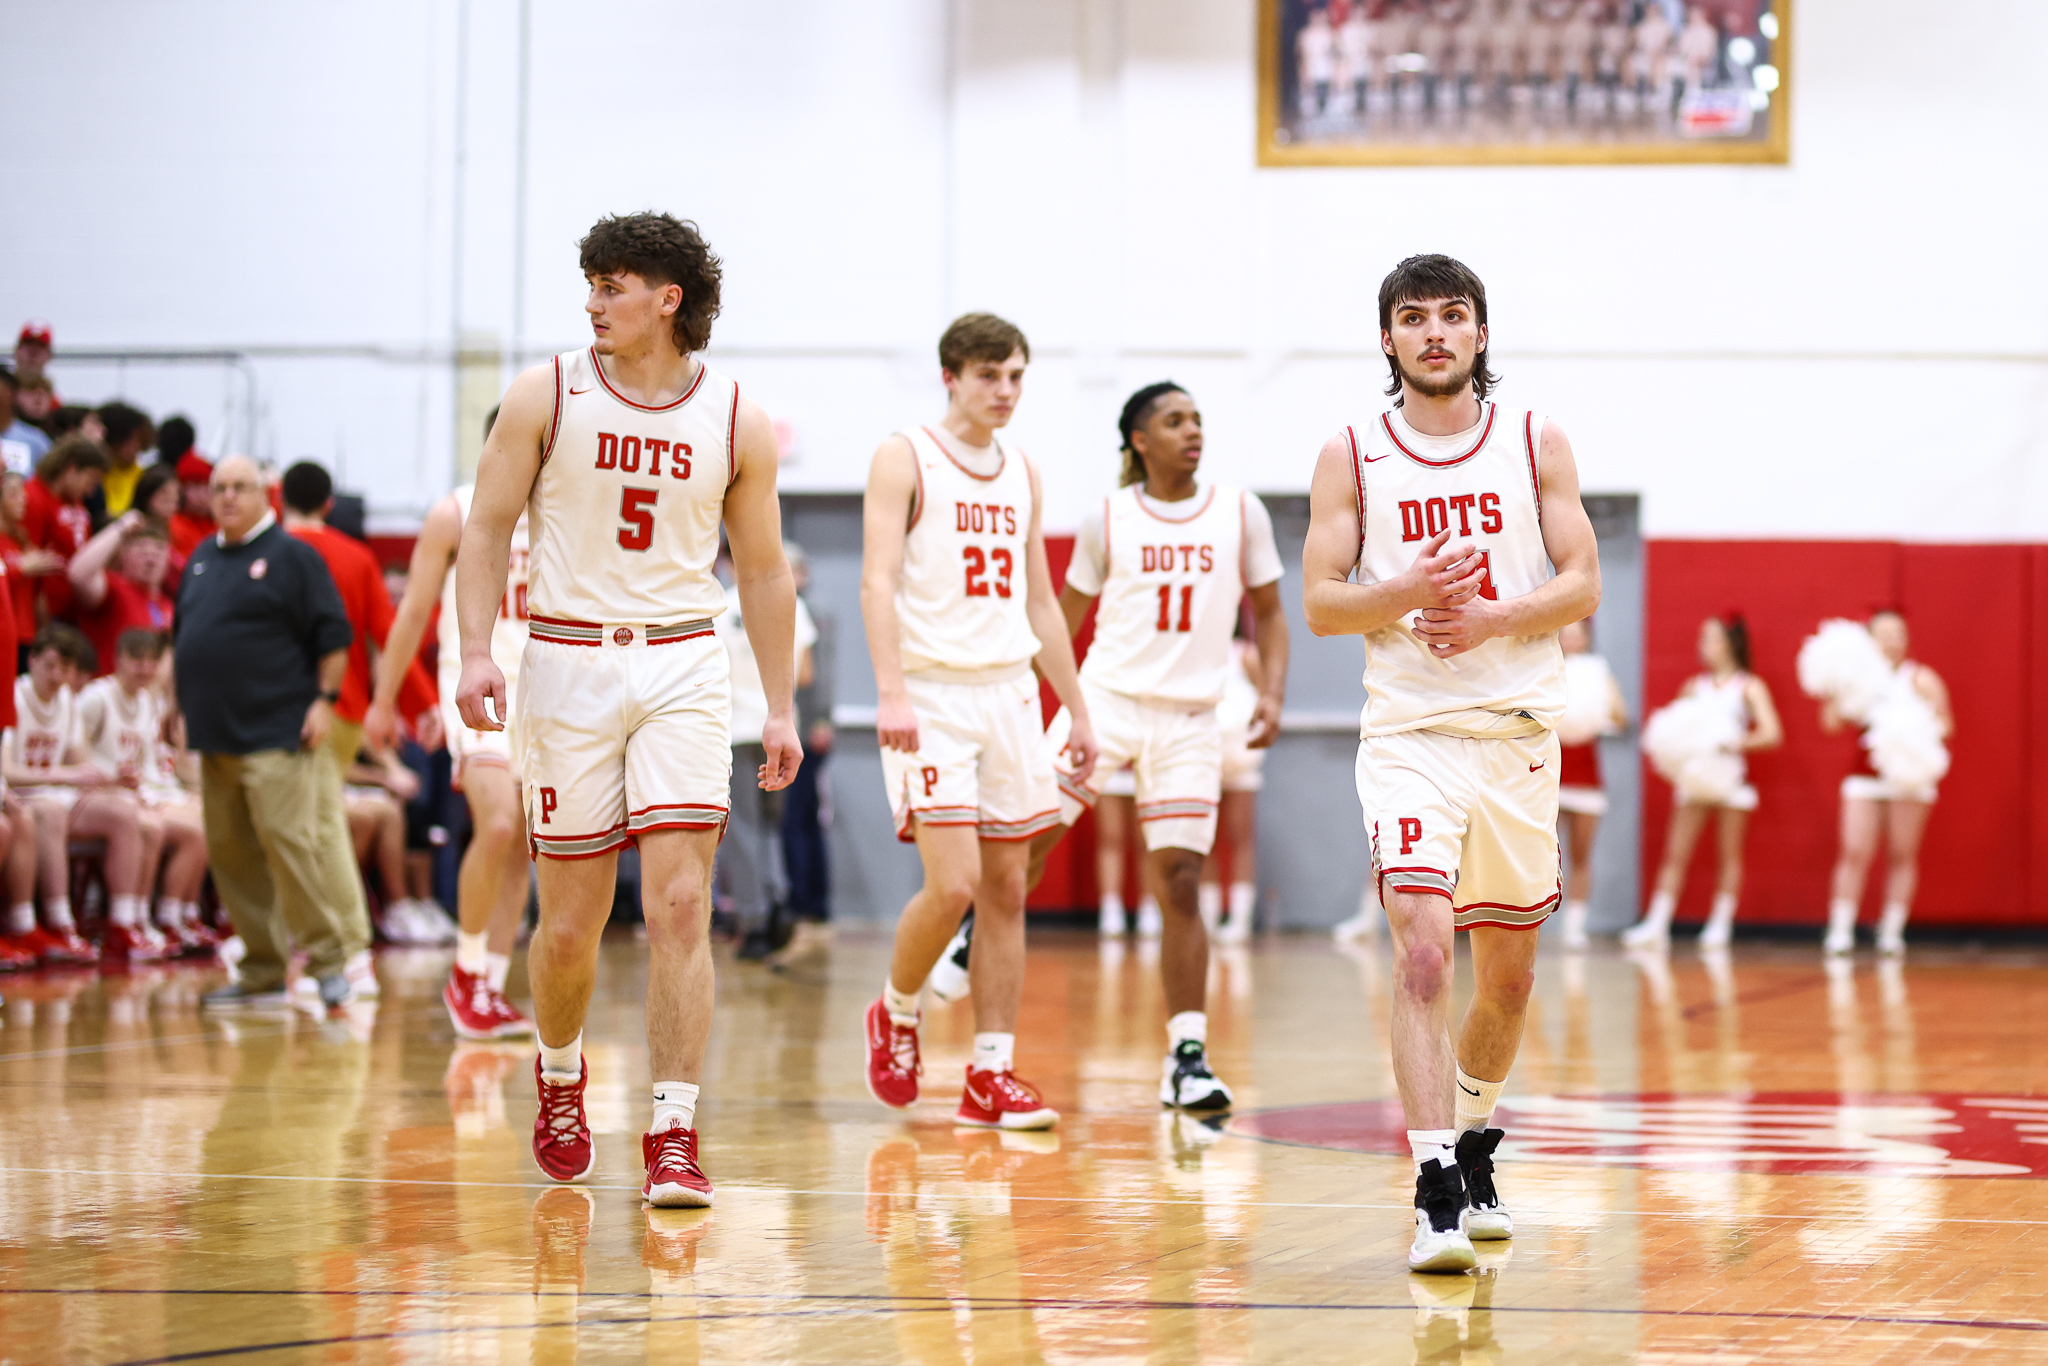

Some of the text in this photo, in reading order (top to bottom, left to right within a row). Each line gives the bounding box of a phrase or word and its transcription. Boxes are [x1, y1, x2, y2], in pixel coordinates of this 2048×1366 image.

[595, 432, 693, 480] DOTS
[616, 485, 659, 553] 5
[955, 501, 1016, 536] DOTS
[1398, 492, 1503, 543] DOTS
[962, 545, 1013, 599] 23
[1141, 545, 1214, 573] DOTS
[1155, 584, 1193, 632] 11
[921, 766, 938, 797] P
[540, 787, 557, 824] P
[1398, 817, 1422, 855] P
